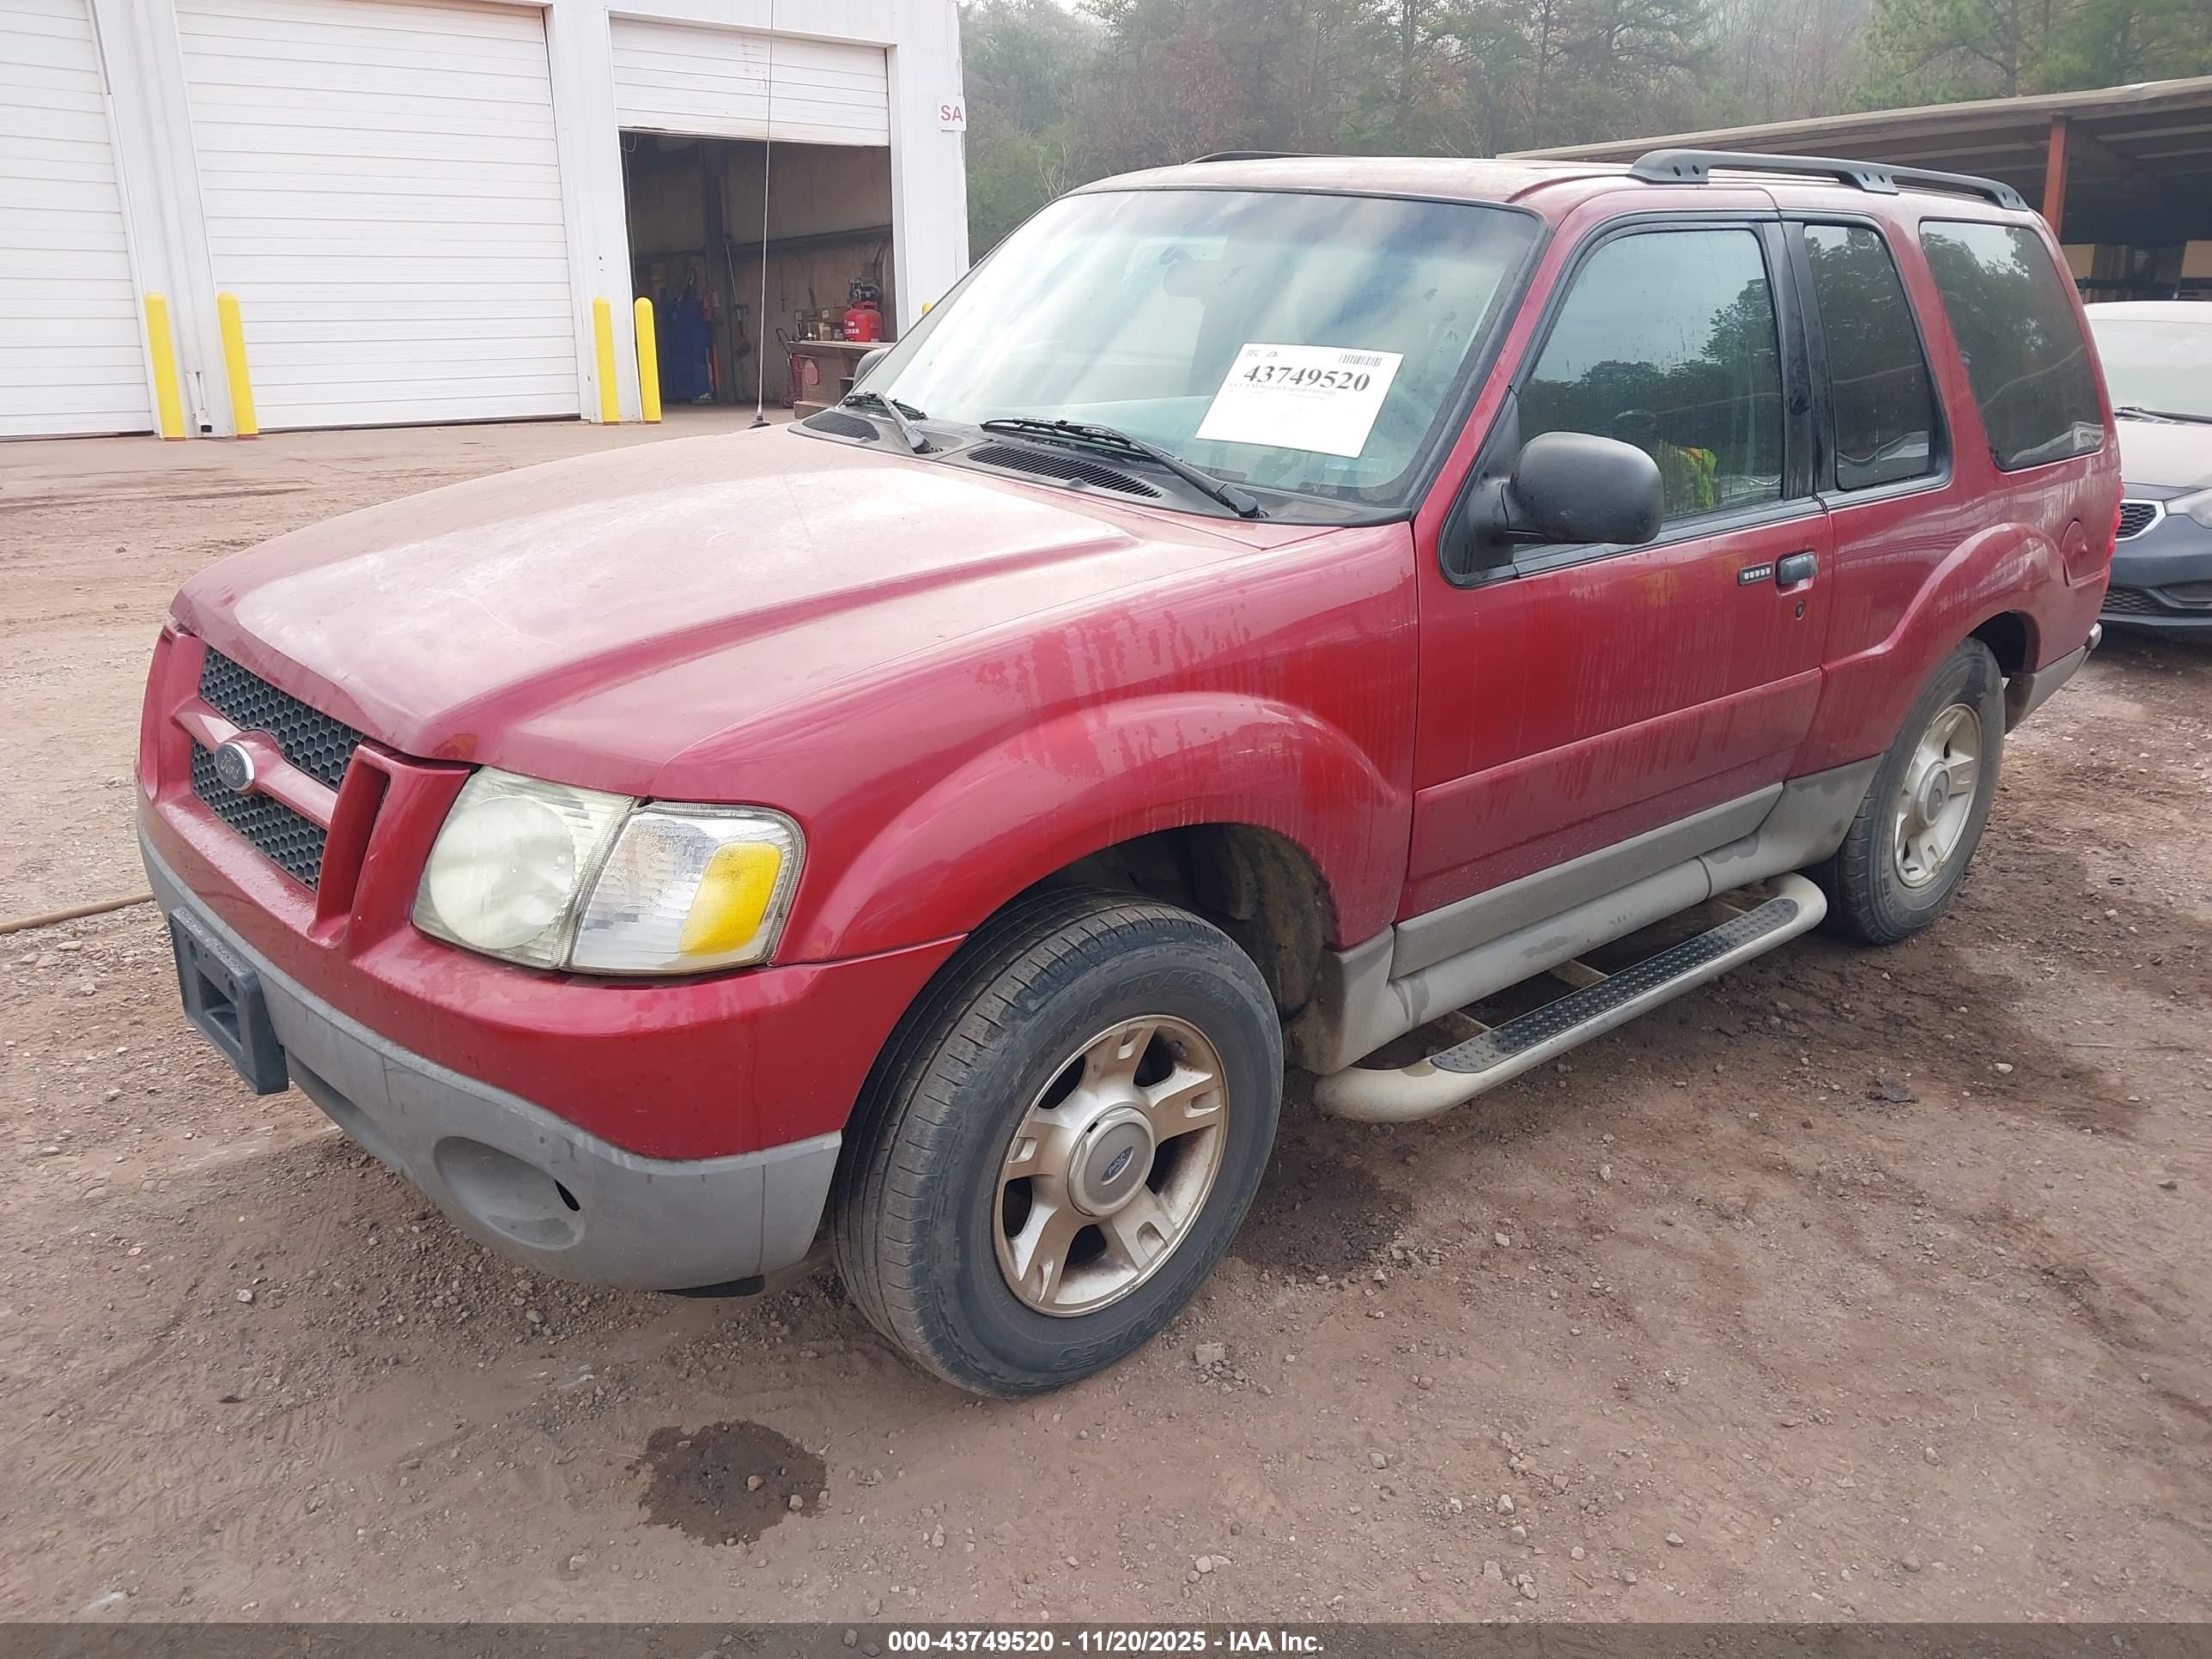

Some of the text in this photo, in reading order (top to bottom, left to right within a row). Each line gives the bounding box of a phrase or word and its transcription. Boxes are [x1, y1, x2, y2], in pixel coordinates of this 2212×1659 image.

[940, 105, 963, 122] SA
[1243, 365, 1370, 392] 43749520
[220, 750, 241, 781] Ford
